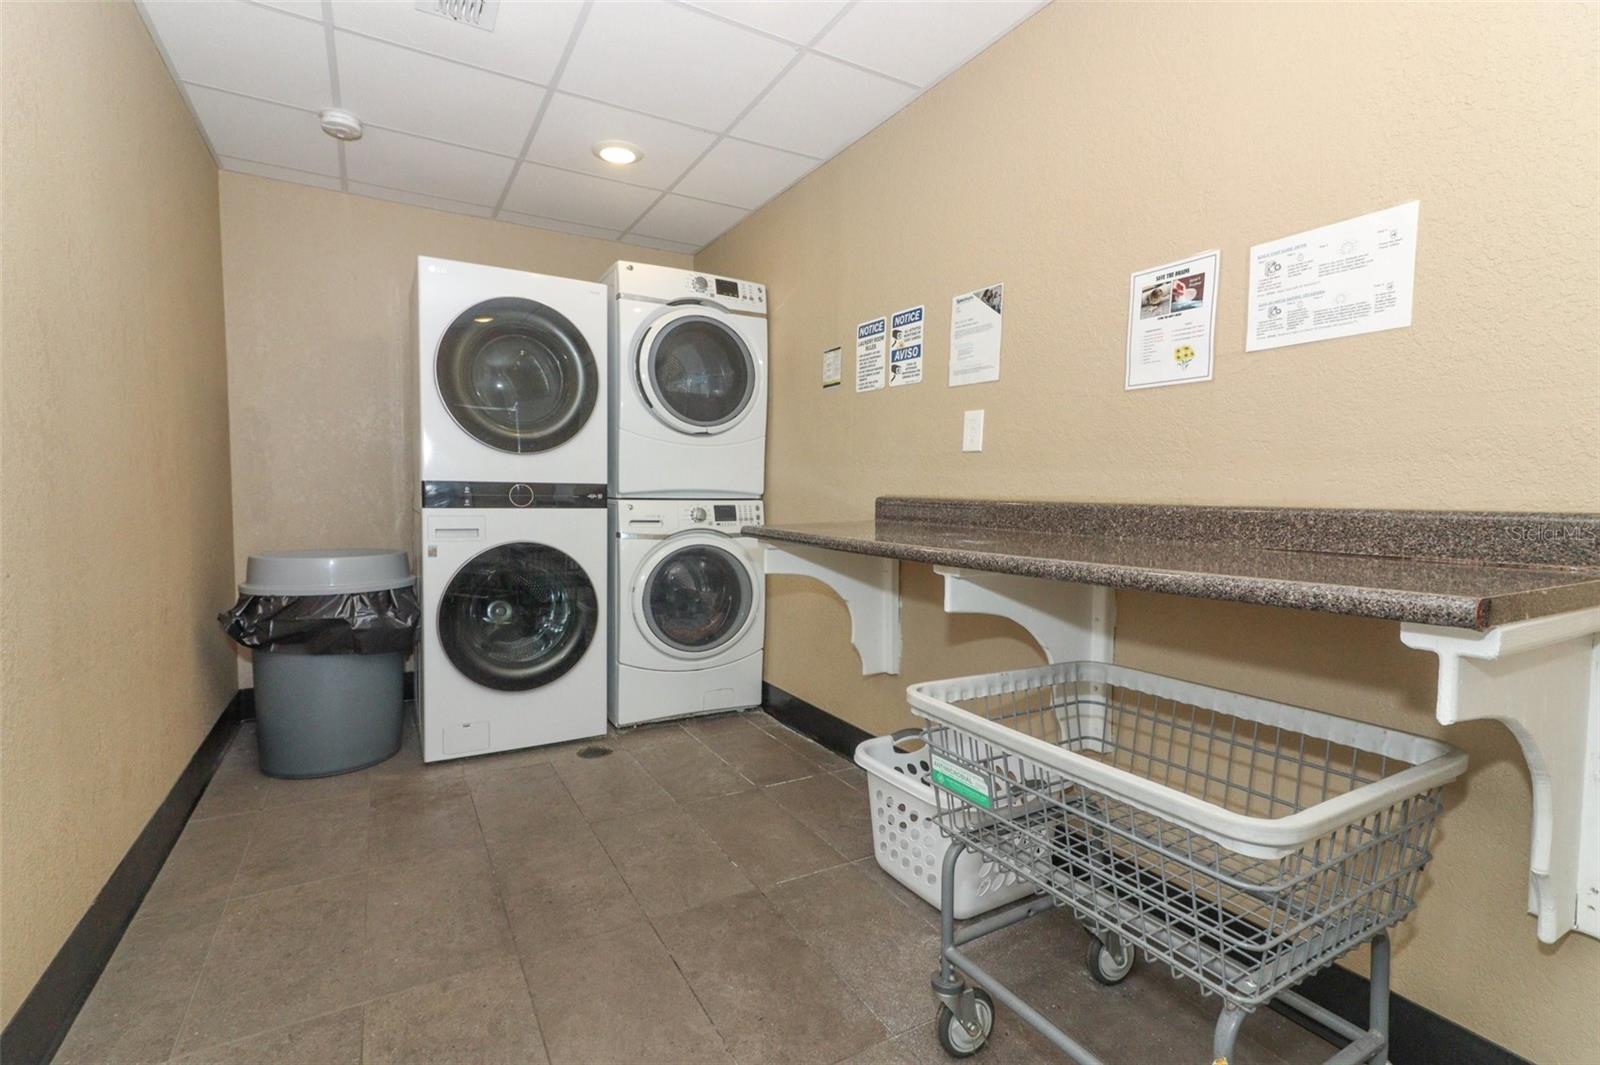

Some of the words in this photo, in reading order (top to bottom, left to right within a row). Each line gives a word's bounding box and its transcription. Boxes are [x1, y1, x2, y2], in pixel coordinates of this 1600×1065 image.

[894, 310, 920, 326] NOTICE
[859, 321, 884, 337] NOTICE
[894, 347, 919, 361] AVISO
